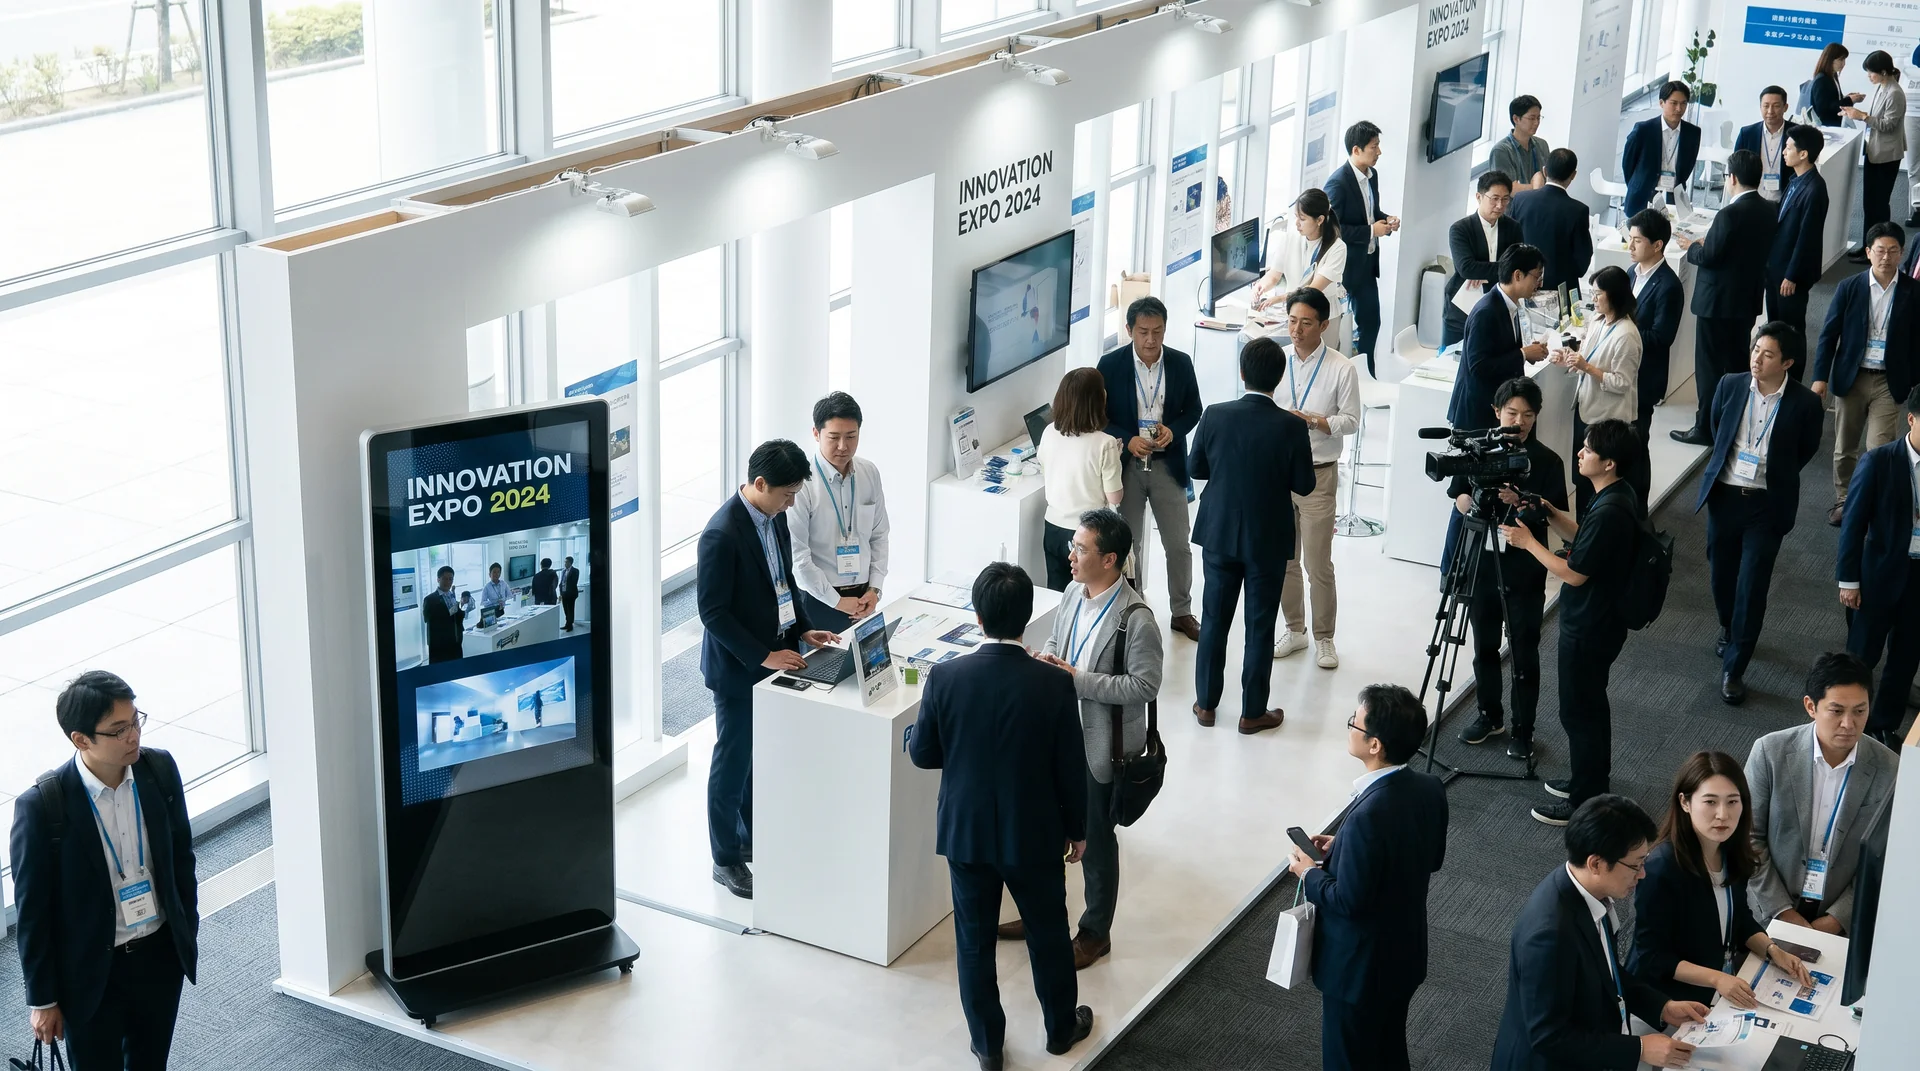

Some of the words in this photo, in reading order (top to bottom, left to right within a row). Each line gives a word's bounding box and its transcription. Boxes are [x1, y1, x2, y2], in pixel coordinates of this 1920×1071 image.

[1426, 25, 1450, 49] EXPO
[1450, 17, 1470, 40] 2024
[1428, 0, 1477, 27] INNOVATION
[959, 150, 1053, 205] INNOVATION
[958, 199, 1001, 236] EXPO
[1004, 183, 1041, 218] 2024
[407, 452, 572, 500] INNOVATION
[408, 494, 483, 527] EXPO
[490, 483, 551, 514] 2024
